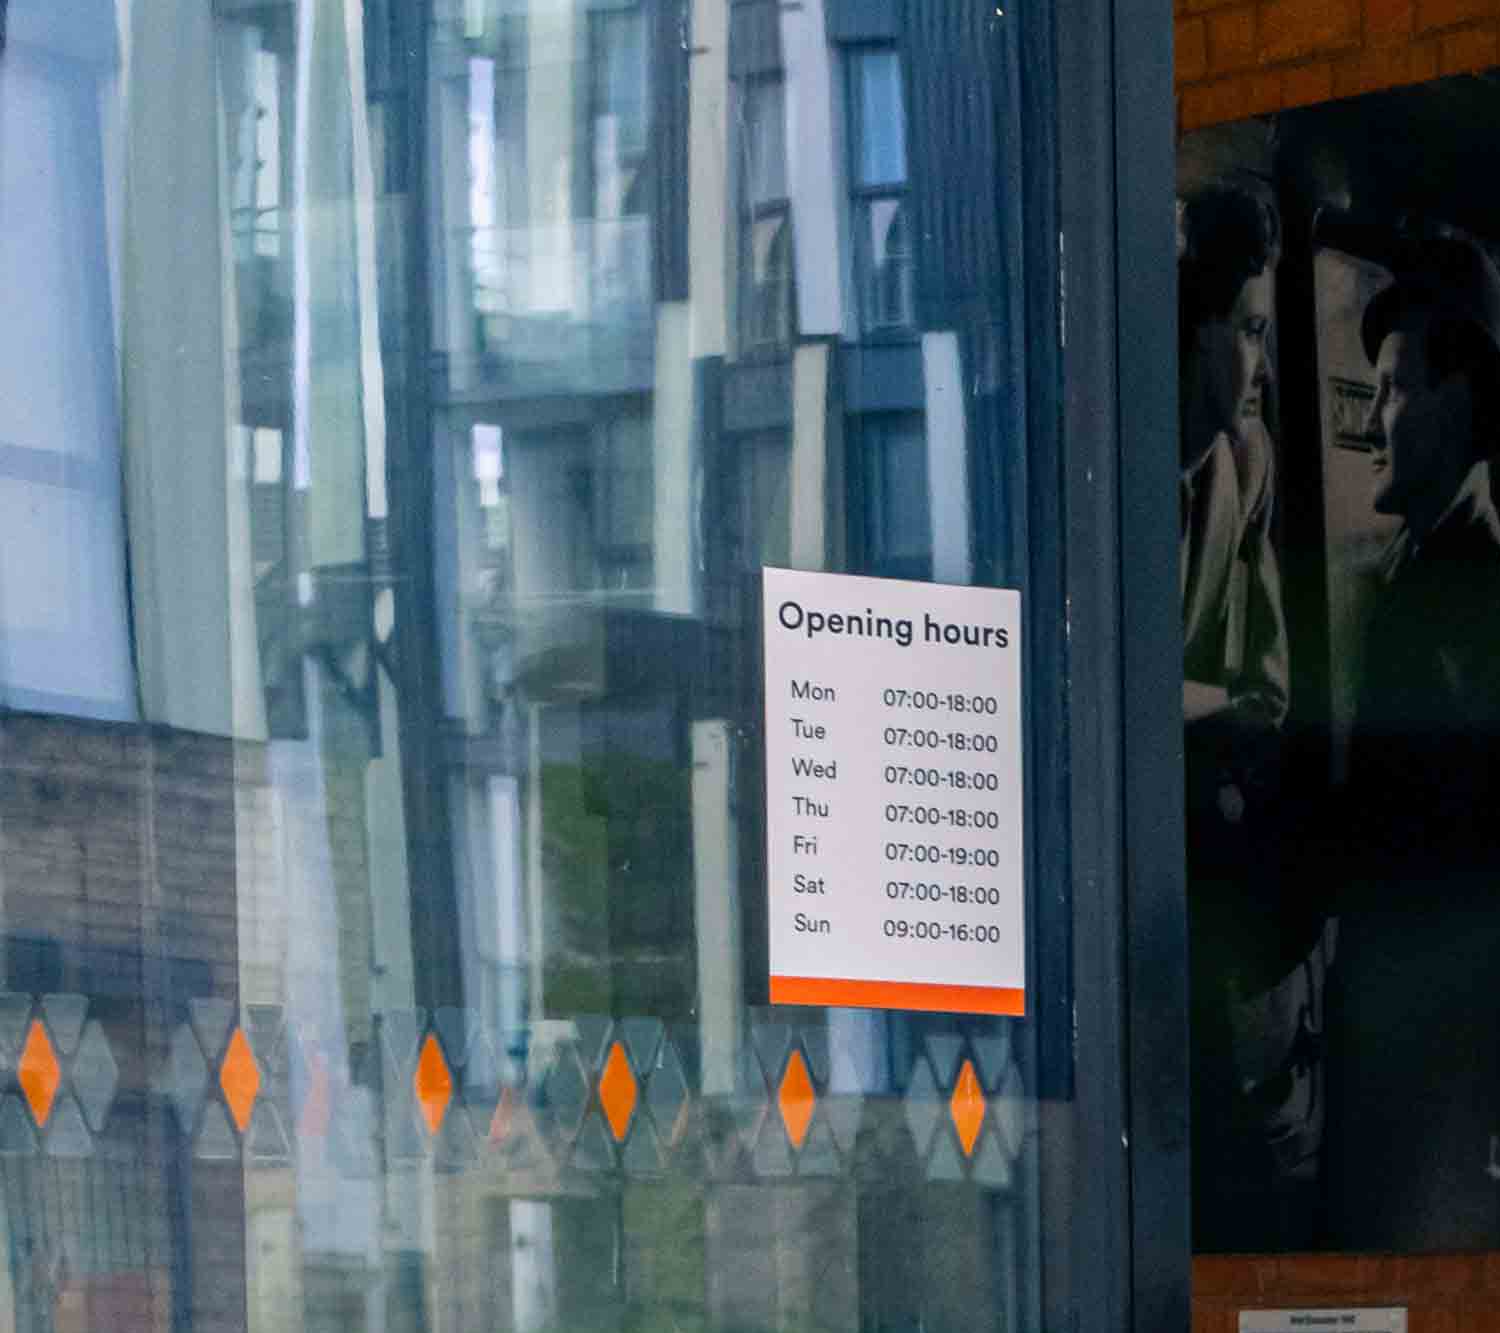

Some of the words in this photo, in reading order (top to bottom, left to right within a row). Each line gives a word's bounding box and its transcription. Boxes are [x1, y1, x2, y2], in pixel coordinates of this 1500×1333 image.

[779, 601, 913, 647] Opening
[924, 614, 1009, 649] hours
[790, 680, 835, 702] Mon
[883, 688, 998, 715] 07:00-18:00
[791, 719, 826, 740] Tue
[884, 727, 998, 753] 07:00-18:00
[791, 757, 837, 780] Wed
[884, 766, 999, 792] 07:00-18:00
[792, 796, 829, 818] Thu
[885, 804, 999, 829] 07:00-18:00
[793, 835, 817, 856] Fri
[885, 843, 1000, 867] 07:00-19:00
[793, 874, 825, 896] Sat
[886, 882, 1000, 906] 07:00-18:00
[794, 913, 831, 935] Sun
[883, 919, 1000, 944] 09:00-16:00
